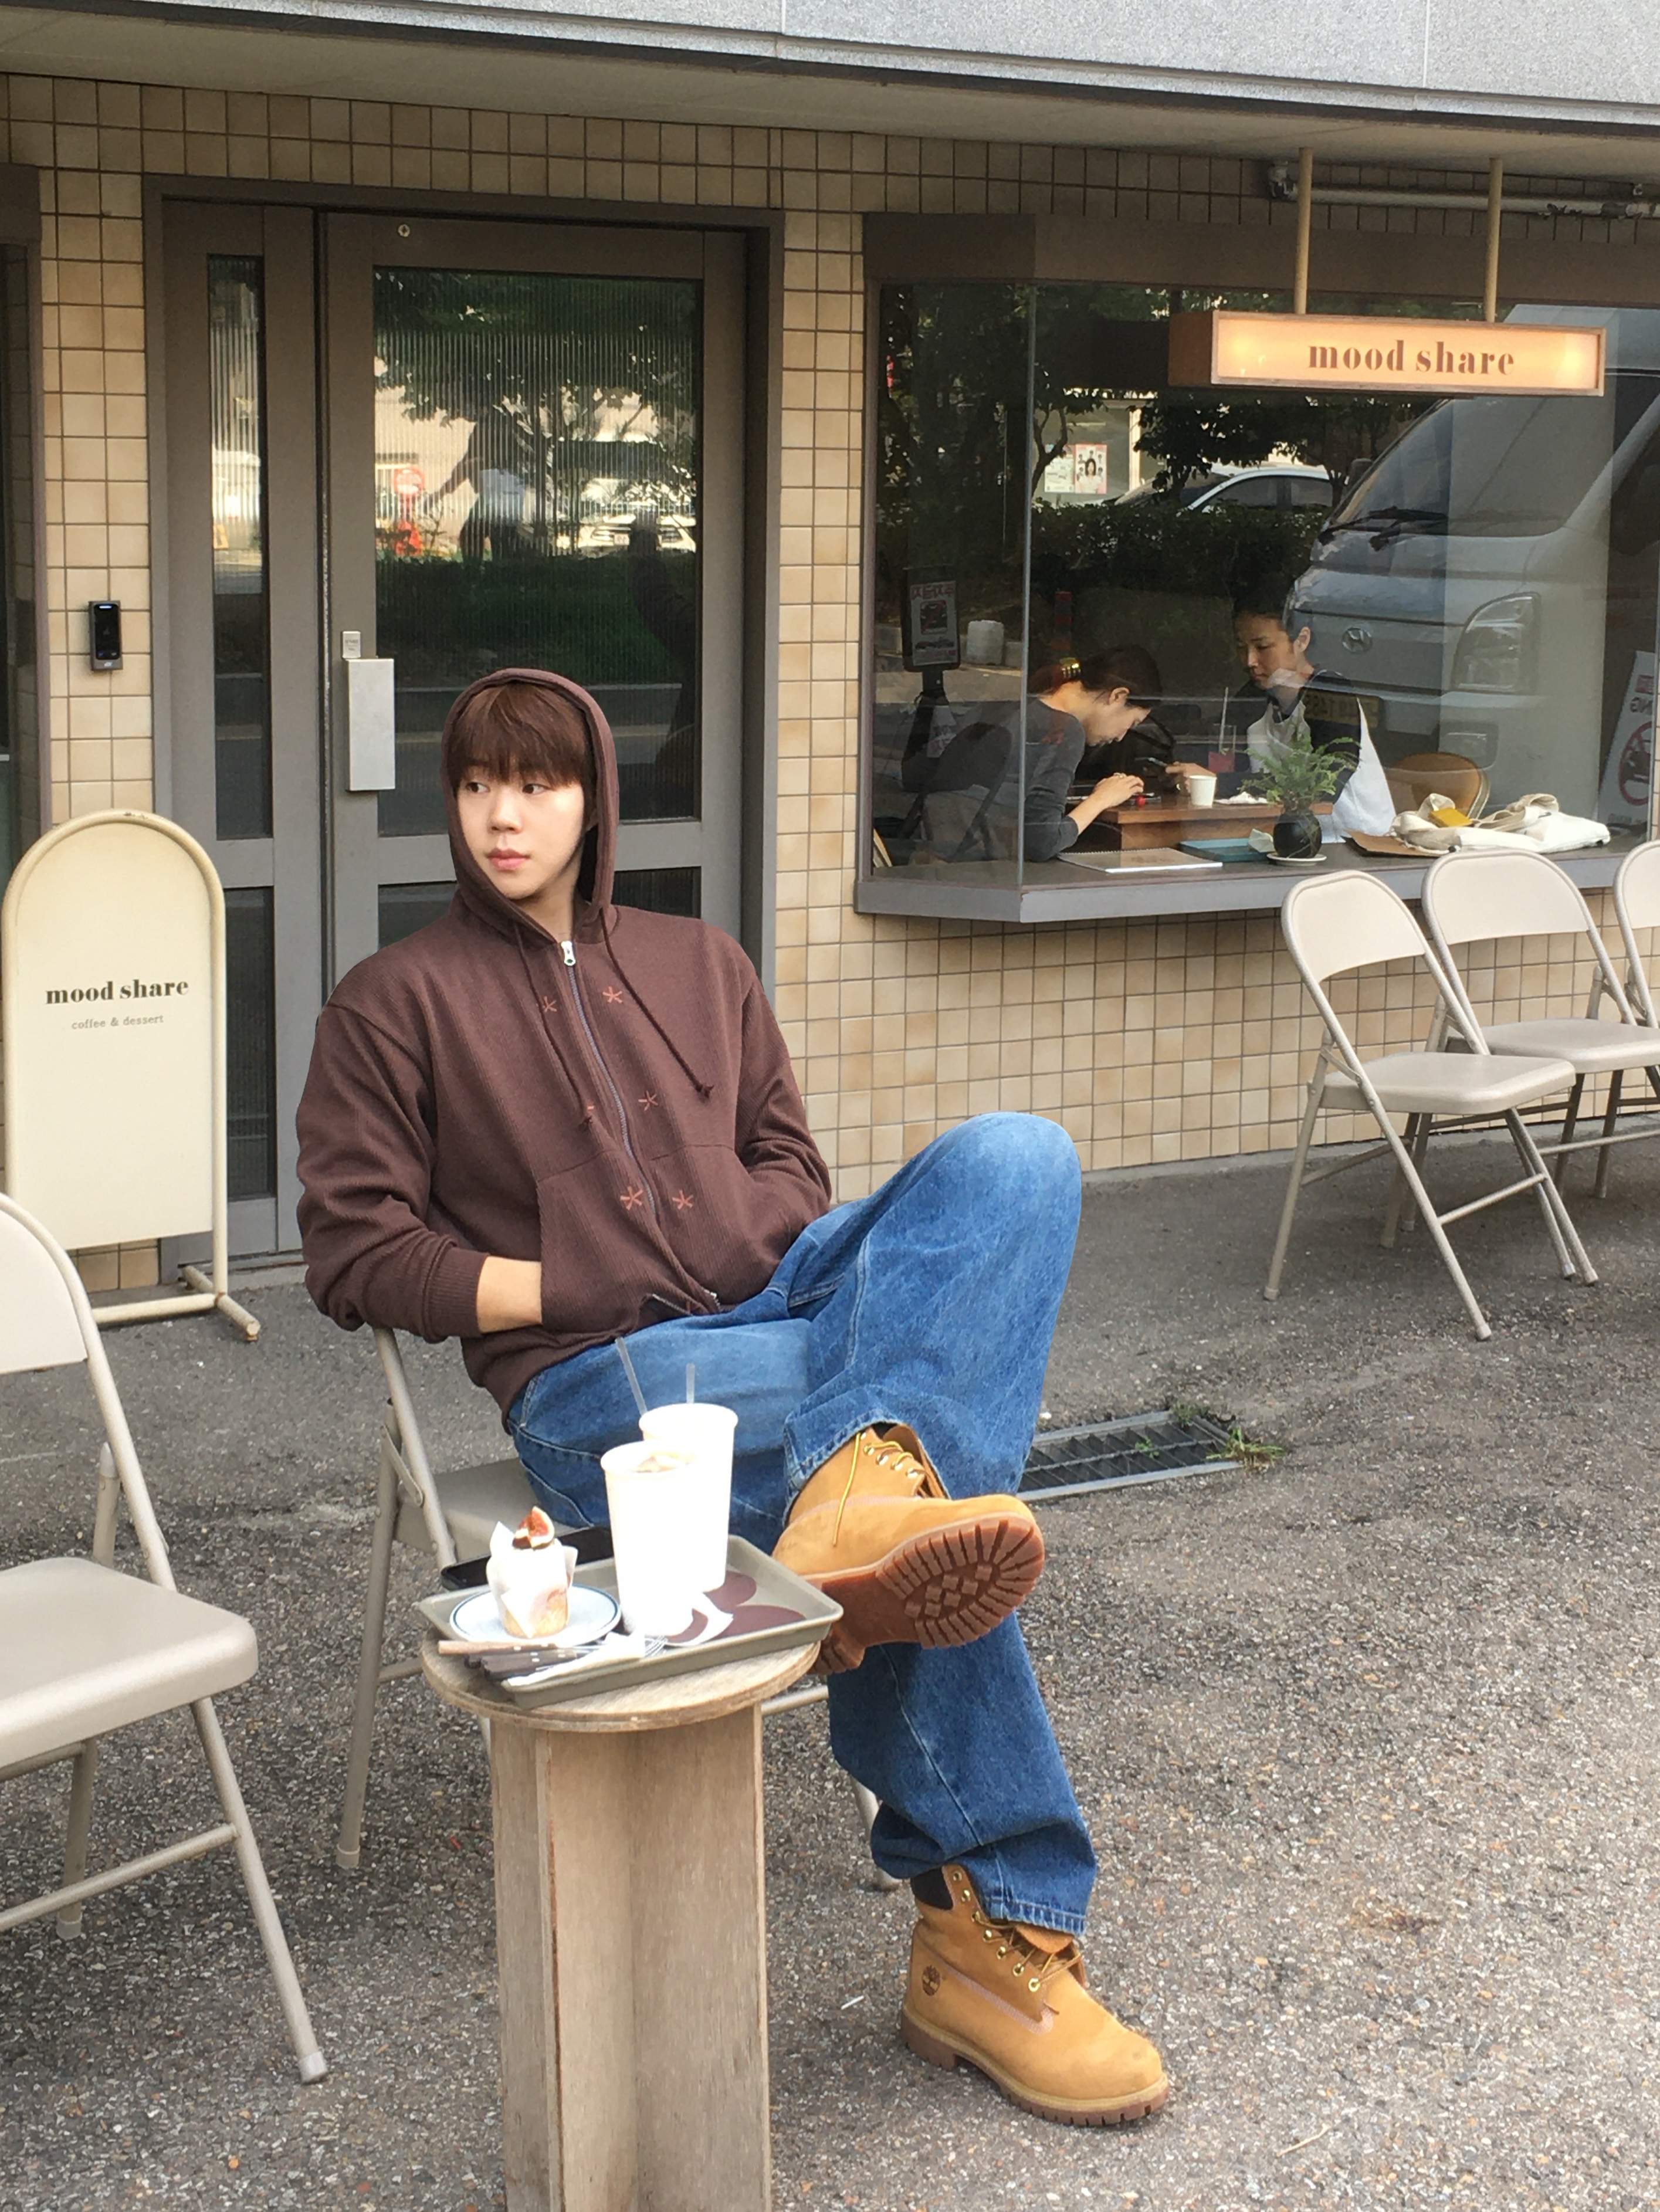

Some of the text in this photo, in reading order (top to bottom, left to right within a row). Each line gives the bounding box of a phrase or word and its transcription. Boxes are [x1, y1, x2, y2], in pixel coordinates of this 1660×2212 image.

[1308, 340, 1515, 375] mood share
[45, 979, 188, 1004] mood share
[71, 1015, 164, 1030] coffee & dessert
